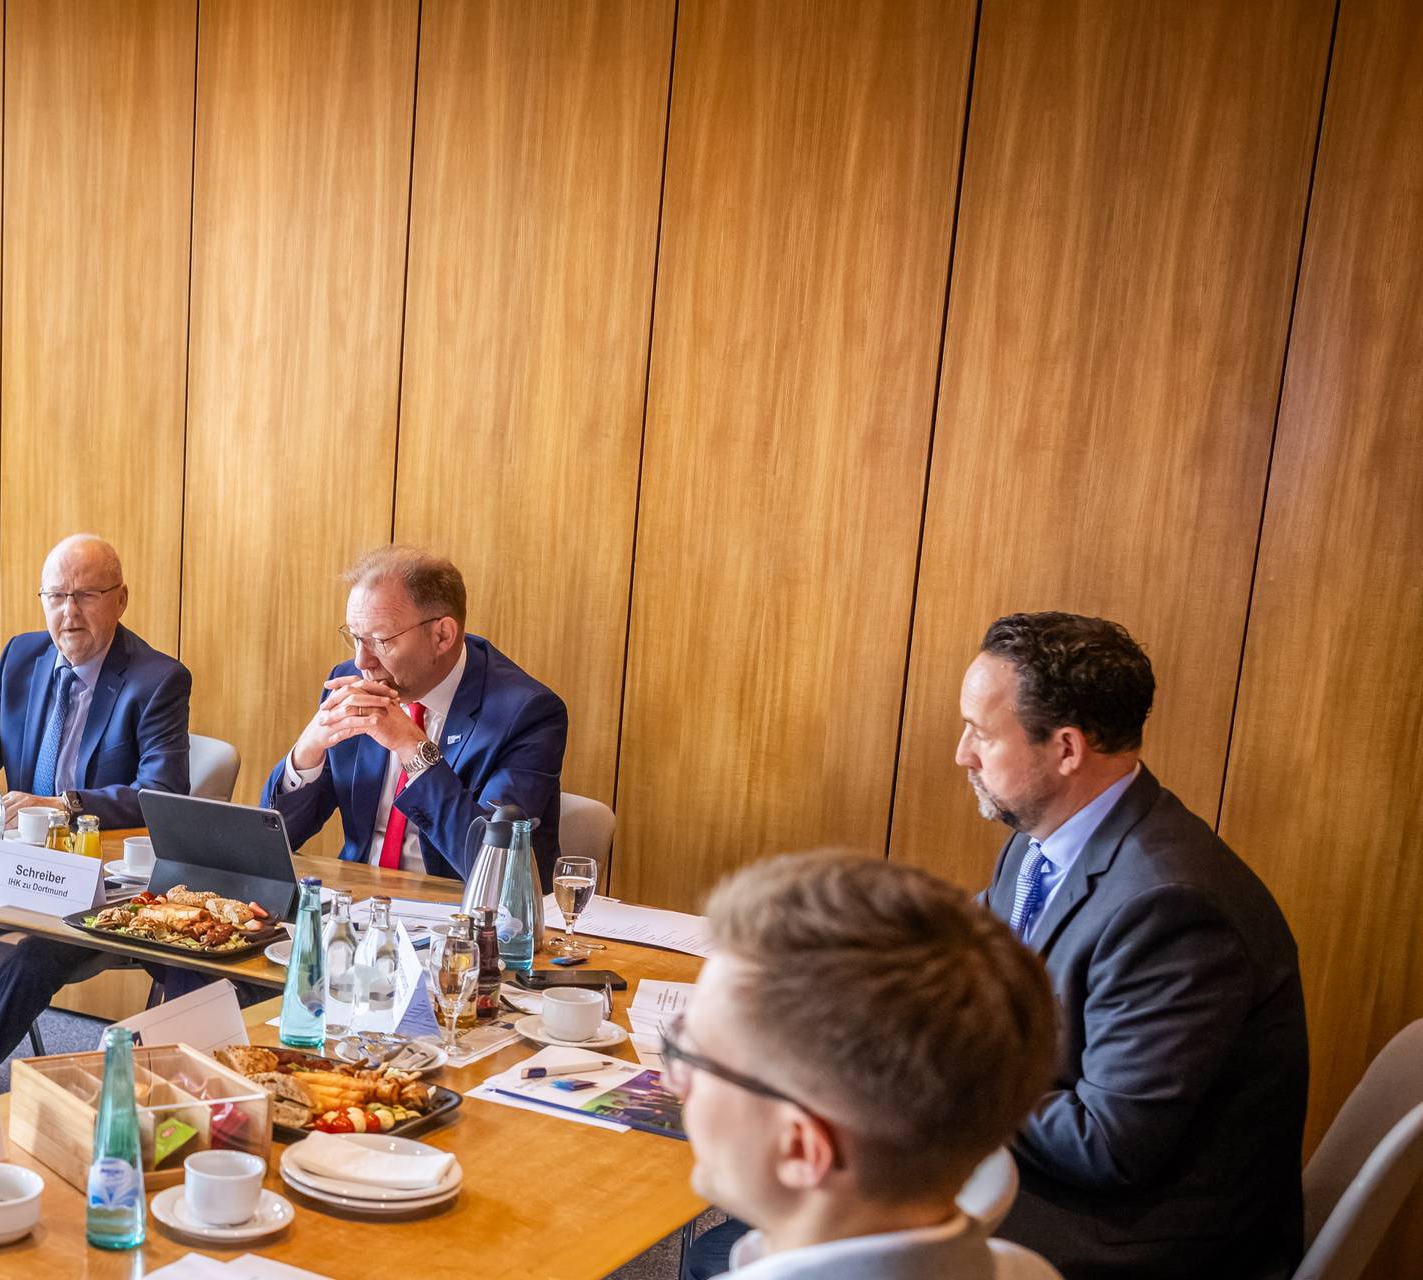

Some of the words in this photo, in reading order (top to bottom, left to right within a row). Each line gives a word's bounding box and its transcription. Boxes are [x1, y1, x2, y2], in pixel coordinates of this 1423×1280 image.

[15, 864, 66, 885] Schreiber
[8, 878, 21, 887] IHK
[22, 882, 31, 890] zu
[32, 882, 69, 898] Dortmund
